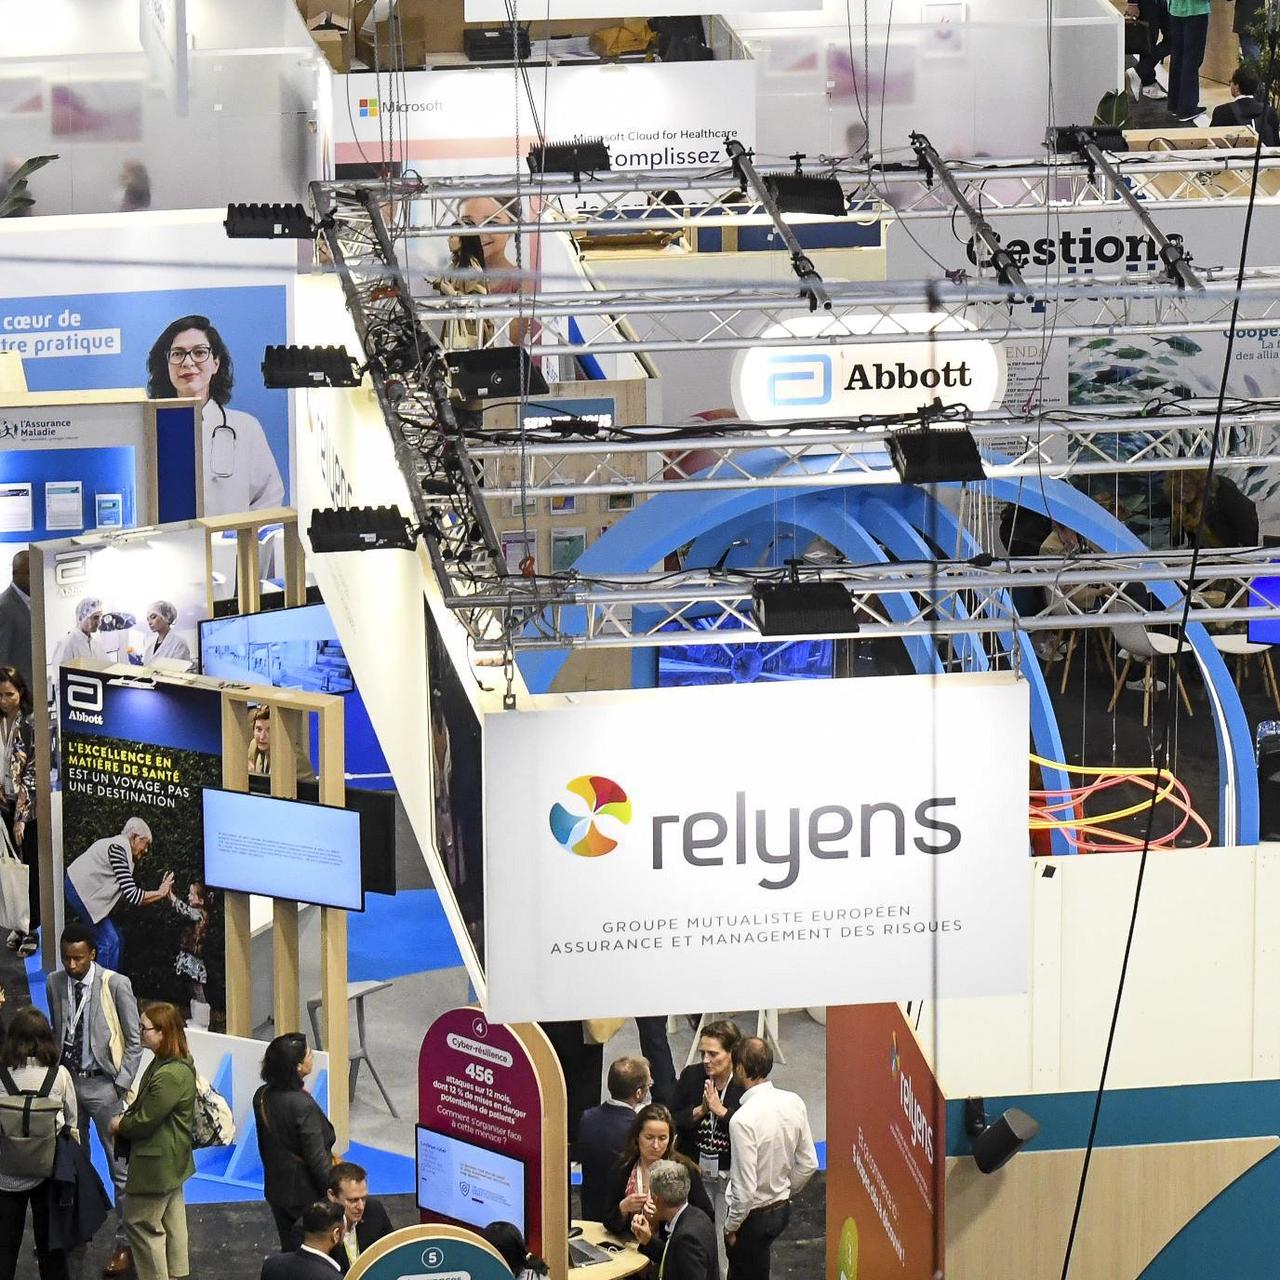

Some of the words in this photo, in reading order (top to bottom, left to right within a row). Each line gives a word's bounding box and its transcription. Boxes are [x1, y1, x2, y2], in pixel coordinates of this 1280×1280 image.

[382, 100, 444, 114] Microsoft
[627, 129, 659, 142] Cloud
[661, 128, 677, 141] for
[679, 127, 738, 140] Healthcare
[3, 314, 53, 331] cœur
[57, 308, 82, 328] de
[33, 333, 115, 357] pratique
[1234, 349, 1254, 362] des
[1260, 338, 1274, 350] La
[843, 360, 973, 391] Abbott
[20, 419, 71, 429] l'Assurance
[20, 427, 56, 437] Maladie
[68, 709, 104, 726] Abbott
[67, 741, 152, 766] L'EXCELLENCE
[155, 755, 172, 769] EN
[68, 754, 120, 773] MATIÈRE
[123, 763, 139, 776] DE
[141, 768, 180, 784] SANTÉ
[68, 767, 89, 780] EST
[92, 771, 109, 785] UN
[112, 775, 165, 796] VOYAGE,
[167, 784, 190, 799] PAS
[68, 781, 93, 795] UNE
[97, 785, 176, 809] DESTINATION
[652, 790, 963, 891] relyens
[601, 918, 680, 935] GROUPE
[686, 911, 804, 931] MUTUALISTE
[811, 902, 911, 922] EUROPÉEN
[550, 936, 664, 956] ASSURANCE
[671, 934, 697, 949] ET
[700, 927, 833, 947] MANAGEMENT
[841, 924, 876, 939] DES
[883, 919, 963, 936] RISQUES
[464, 1062, 495, 1086] 456
[428, 1251, 437, 1264] 5
